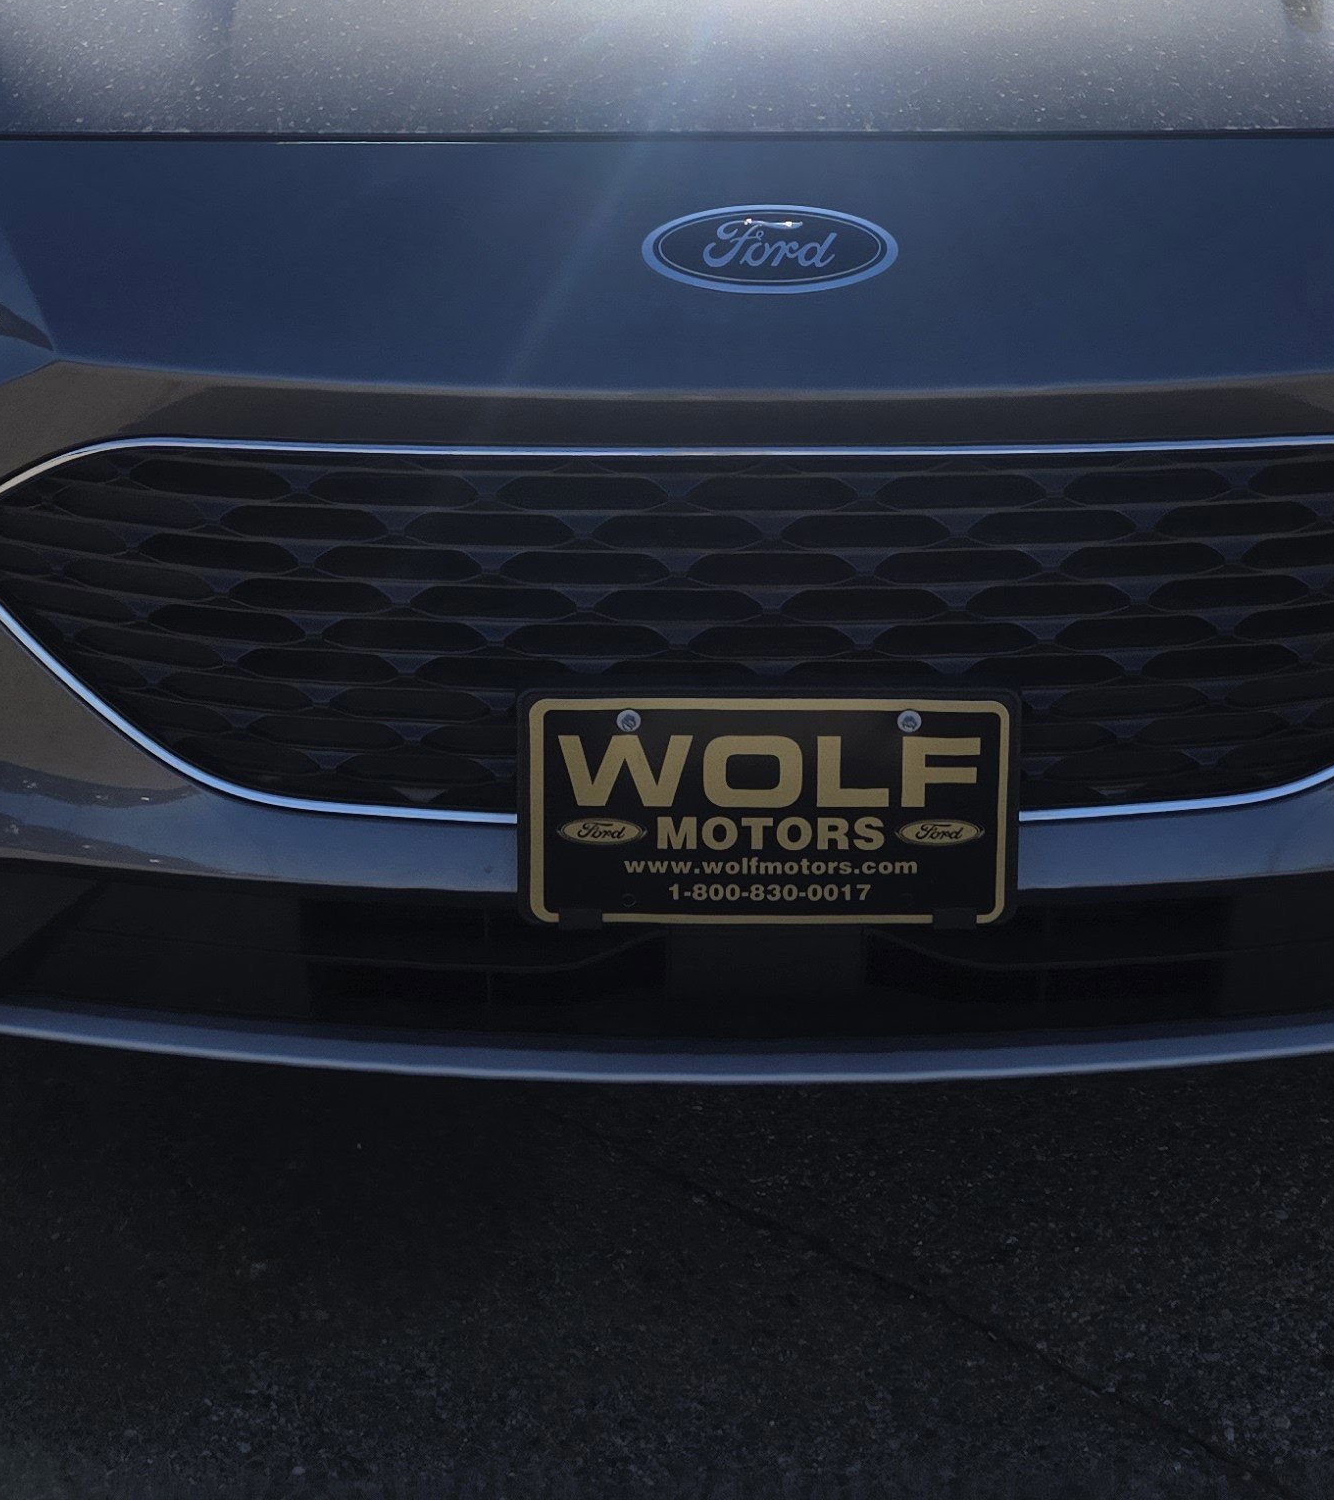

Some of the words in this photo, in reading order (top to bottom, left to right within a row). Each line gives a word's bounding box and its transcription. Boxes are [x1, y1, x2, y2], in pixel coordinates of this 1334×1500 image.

[702, 217, 838, 268] Ford
[557, 734, 982, 808] WOLF
[575, 820, 628, 841] Ford
[655, 816, 886, 851] MOTORS
[914, 820, 964, 841] Ford
[623, 857, 919, 876] www.wolfmotors.com
[667, 883, 872, 902] 1-800-830-0017
